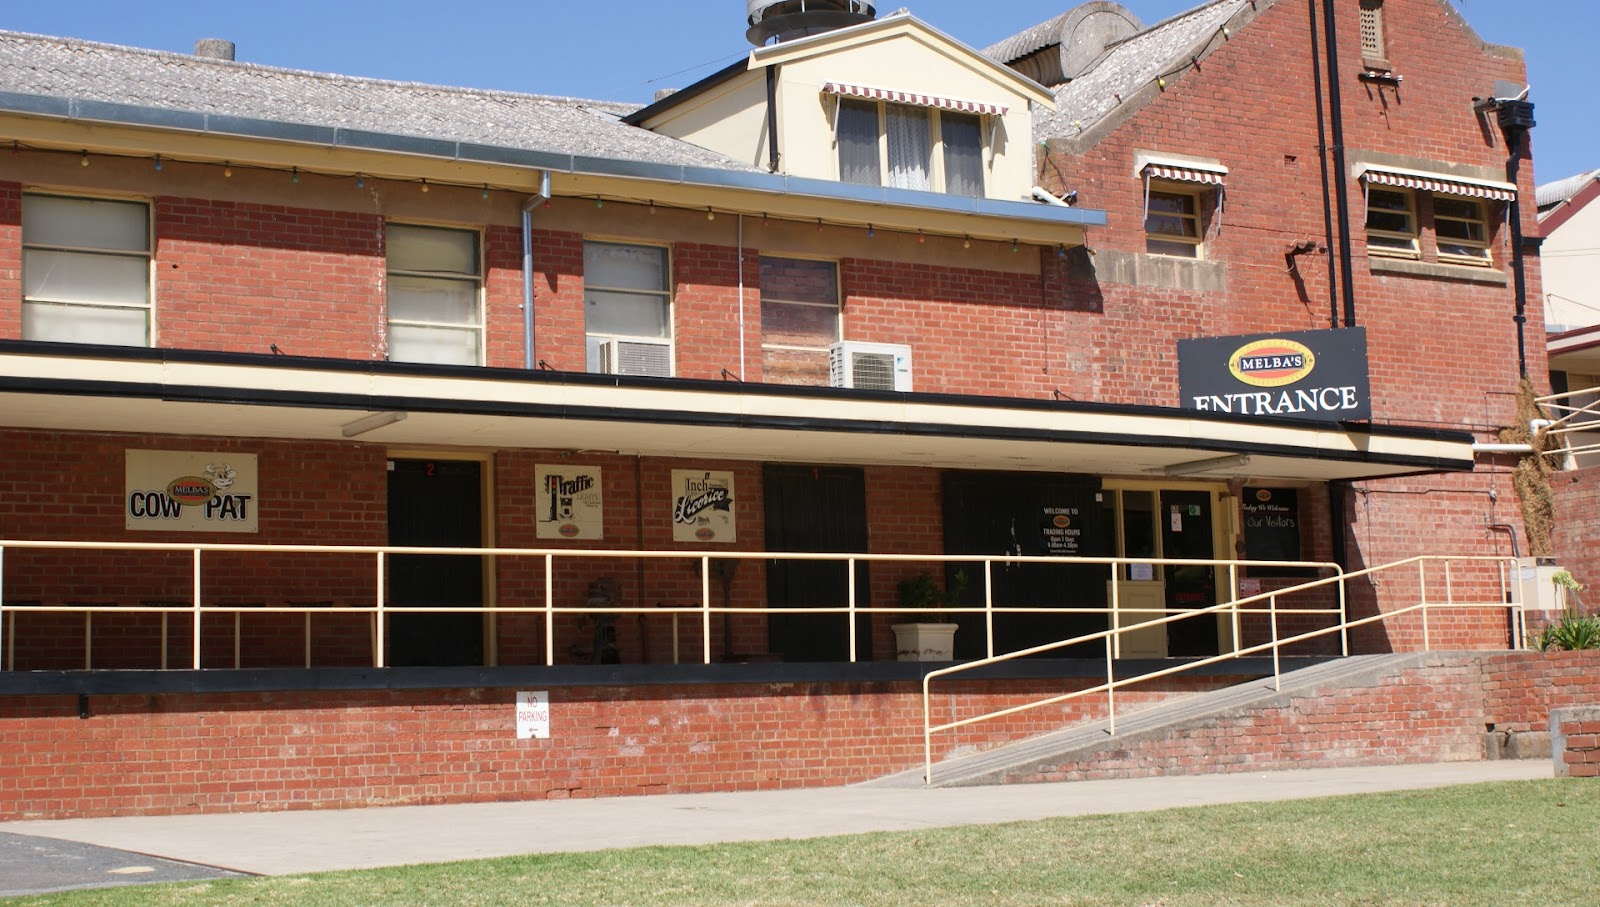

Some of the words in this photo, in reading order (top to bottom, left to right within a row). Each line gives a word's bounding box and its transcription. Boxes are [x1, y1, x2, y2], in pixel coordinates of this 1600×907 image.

[1242, 355, 1302, 370] MELBA'S
[1193, 386, 1358, 415] ENTRANCE
[427, 463, 435, 476] 2
[686, 478, 708, 492] Inch
[129, 491, 182, 519] COW
[205, 493, 253, 520] PAT
[674, 488, 725, 525] Licorice
[1043, 507, 1070, 515] WELCOME
[1242, 504, 1257, 512] Today
[1247, 517, 1263, 528] Our
[1265, 515, 1295, 528] Visitors
[1043, 528, 1064, 536] TRADING
[527, 697, 538, 707] NO
[519, 711, 548, 722] PARKING
